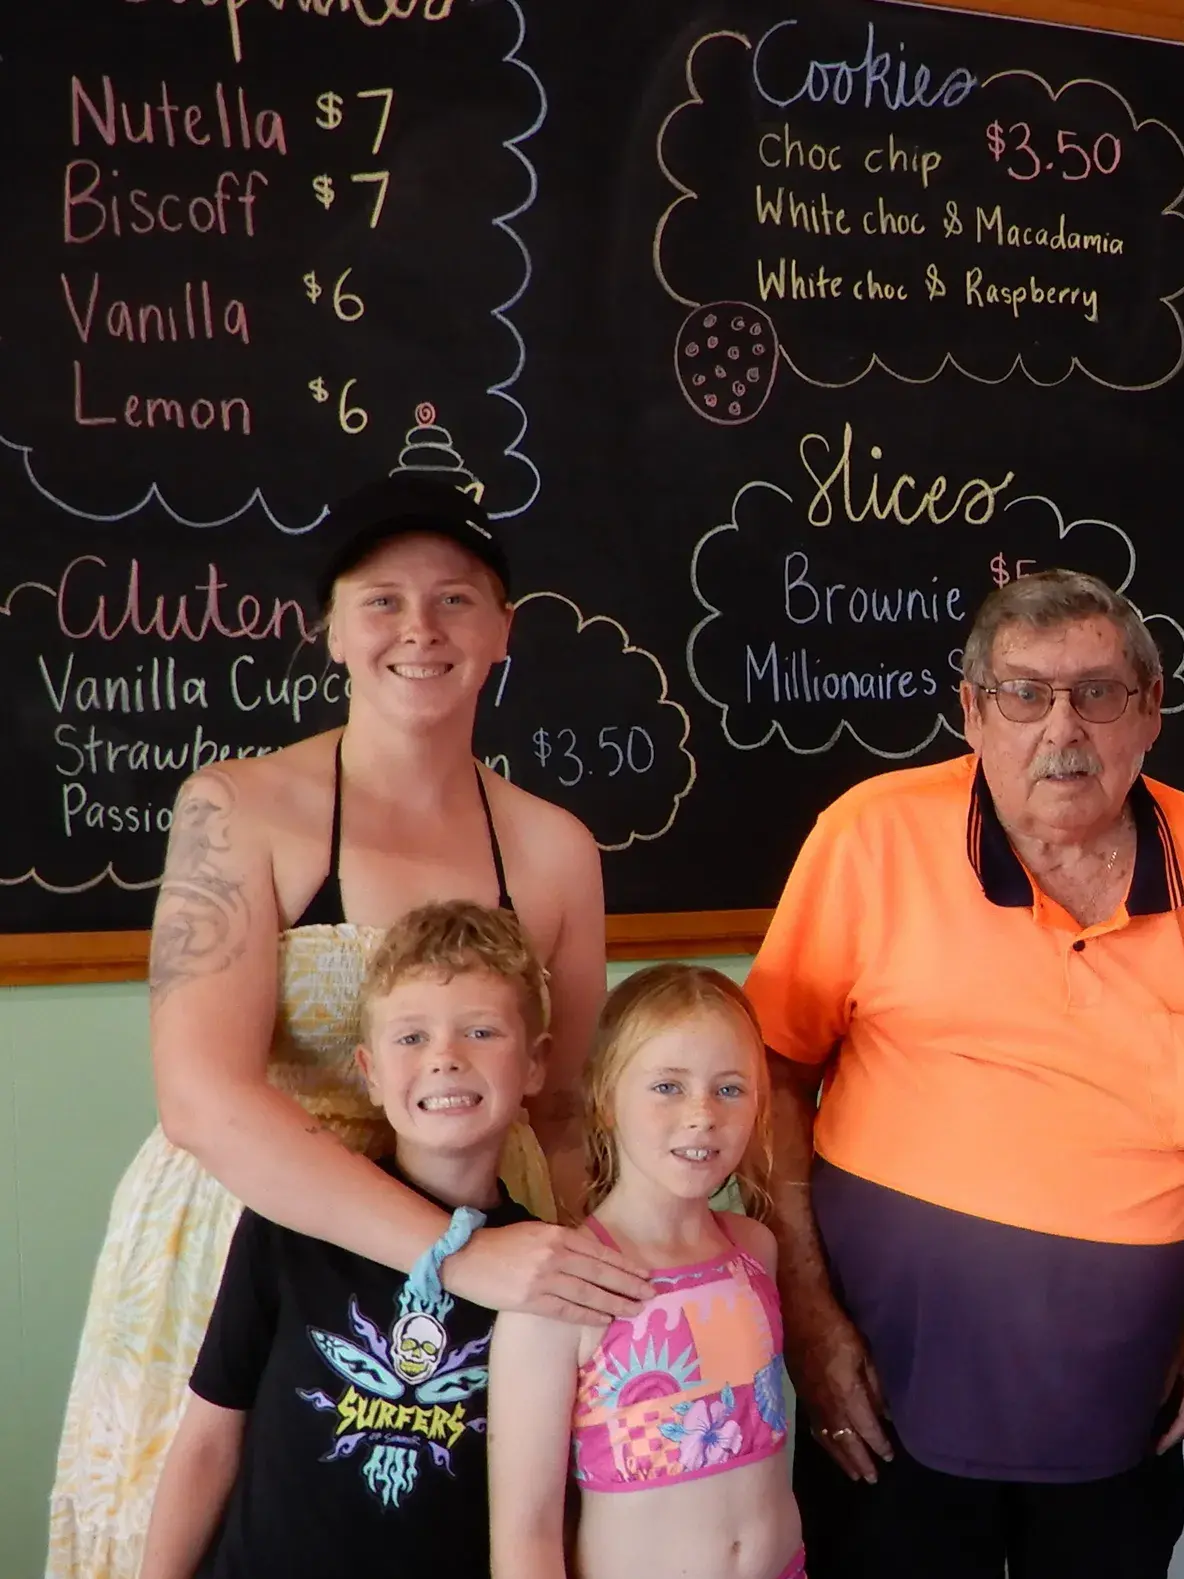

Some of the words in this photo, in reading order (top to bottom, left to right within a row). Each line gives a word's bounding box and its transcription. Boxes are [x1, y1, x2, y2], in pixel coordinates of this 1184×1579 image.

[753, 20, 978, 110] Cookies
[72, 76, 286, 155] Nutella
[865, 134, 941, 188] chip
[987, 120, 1120, 180] $3.50
[64, 160, 268, 242] Biscoff
[756, 185, 850, 235] White
[863, 197, 925, 234] choc
[977, 206, 1123, 254] Macadamia
[61, 273, 249, 344] Vanilla
[303, 268, 364, 321] $6
[758, 258, 842, 301] White
[853, 270, 907, 300] choc
[966, 267, 1097, 321] Raspberry
[74, 361, 250, 435] Lemon
[309, 377, 368, 434] $6
[800, 422, 1015, 527] Slices
[58, 555, 318, 642] Gluten
[785, 552, 965, 624] Brownie
[39, 653, 208, 713] Vanilla
[230, 655, 352, 723] Cupc
[747, 642, 936, 703] Millionaires
[54, 722, 284, 776] Strawbe
[533, 727, 654, 785] $3.50
[61, 782, 173, 838] Passio
[335, 1384, 467, 1448] SURFERS
